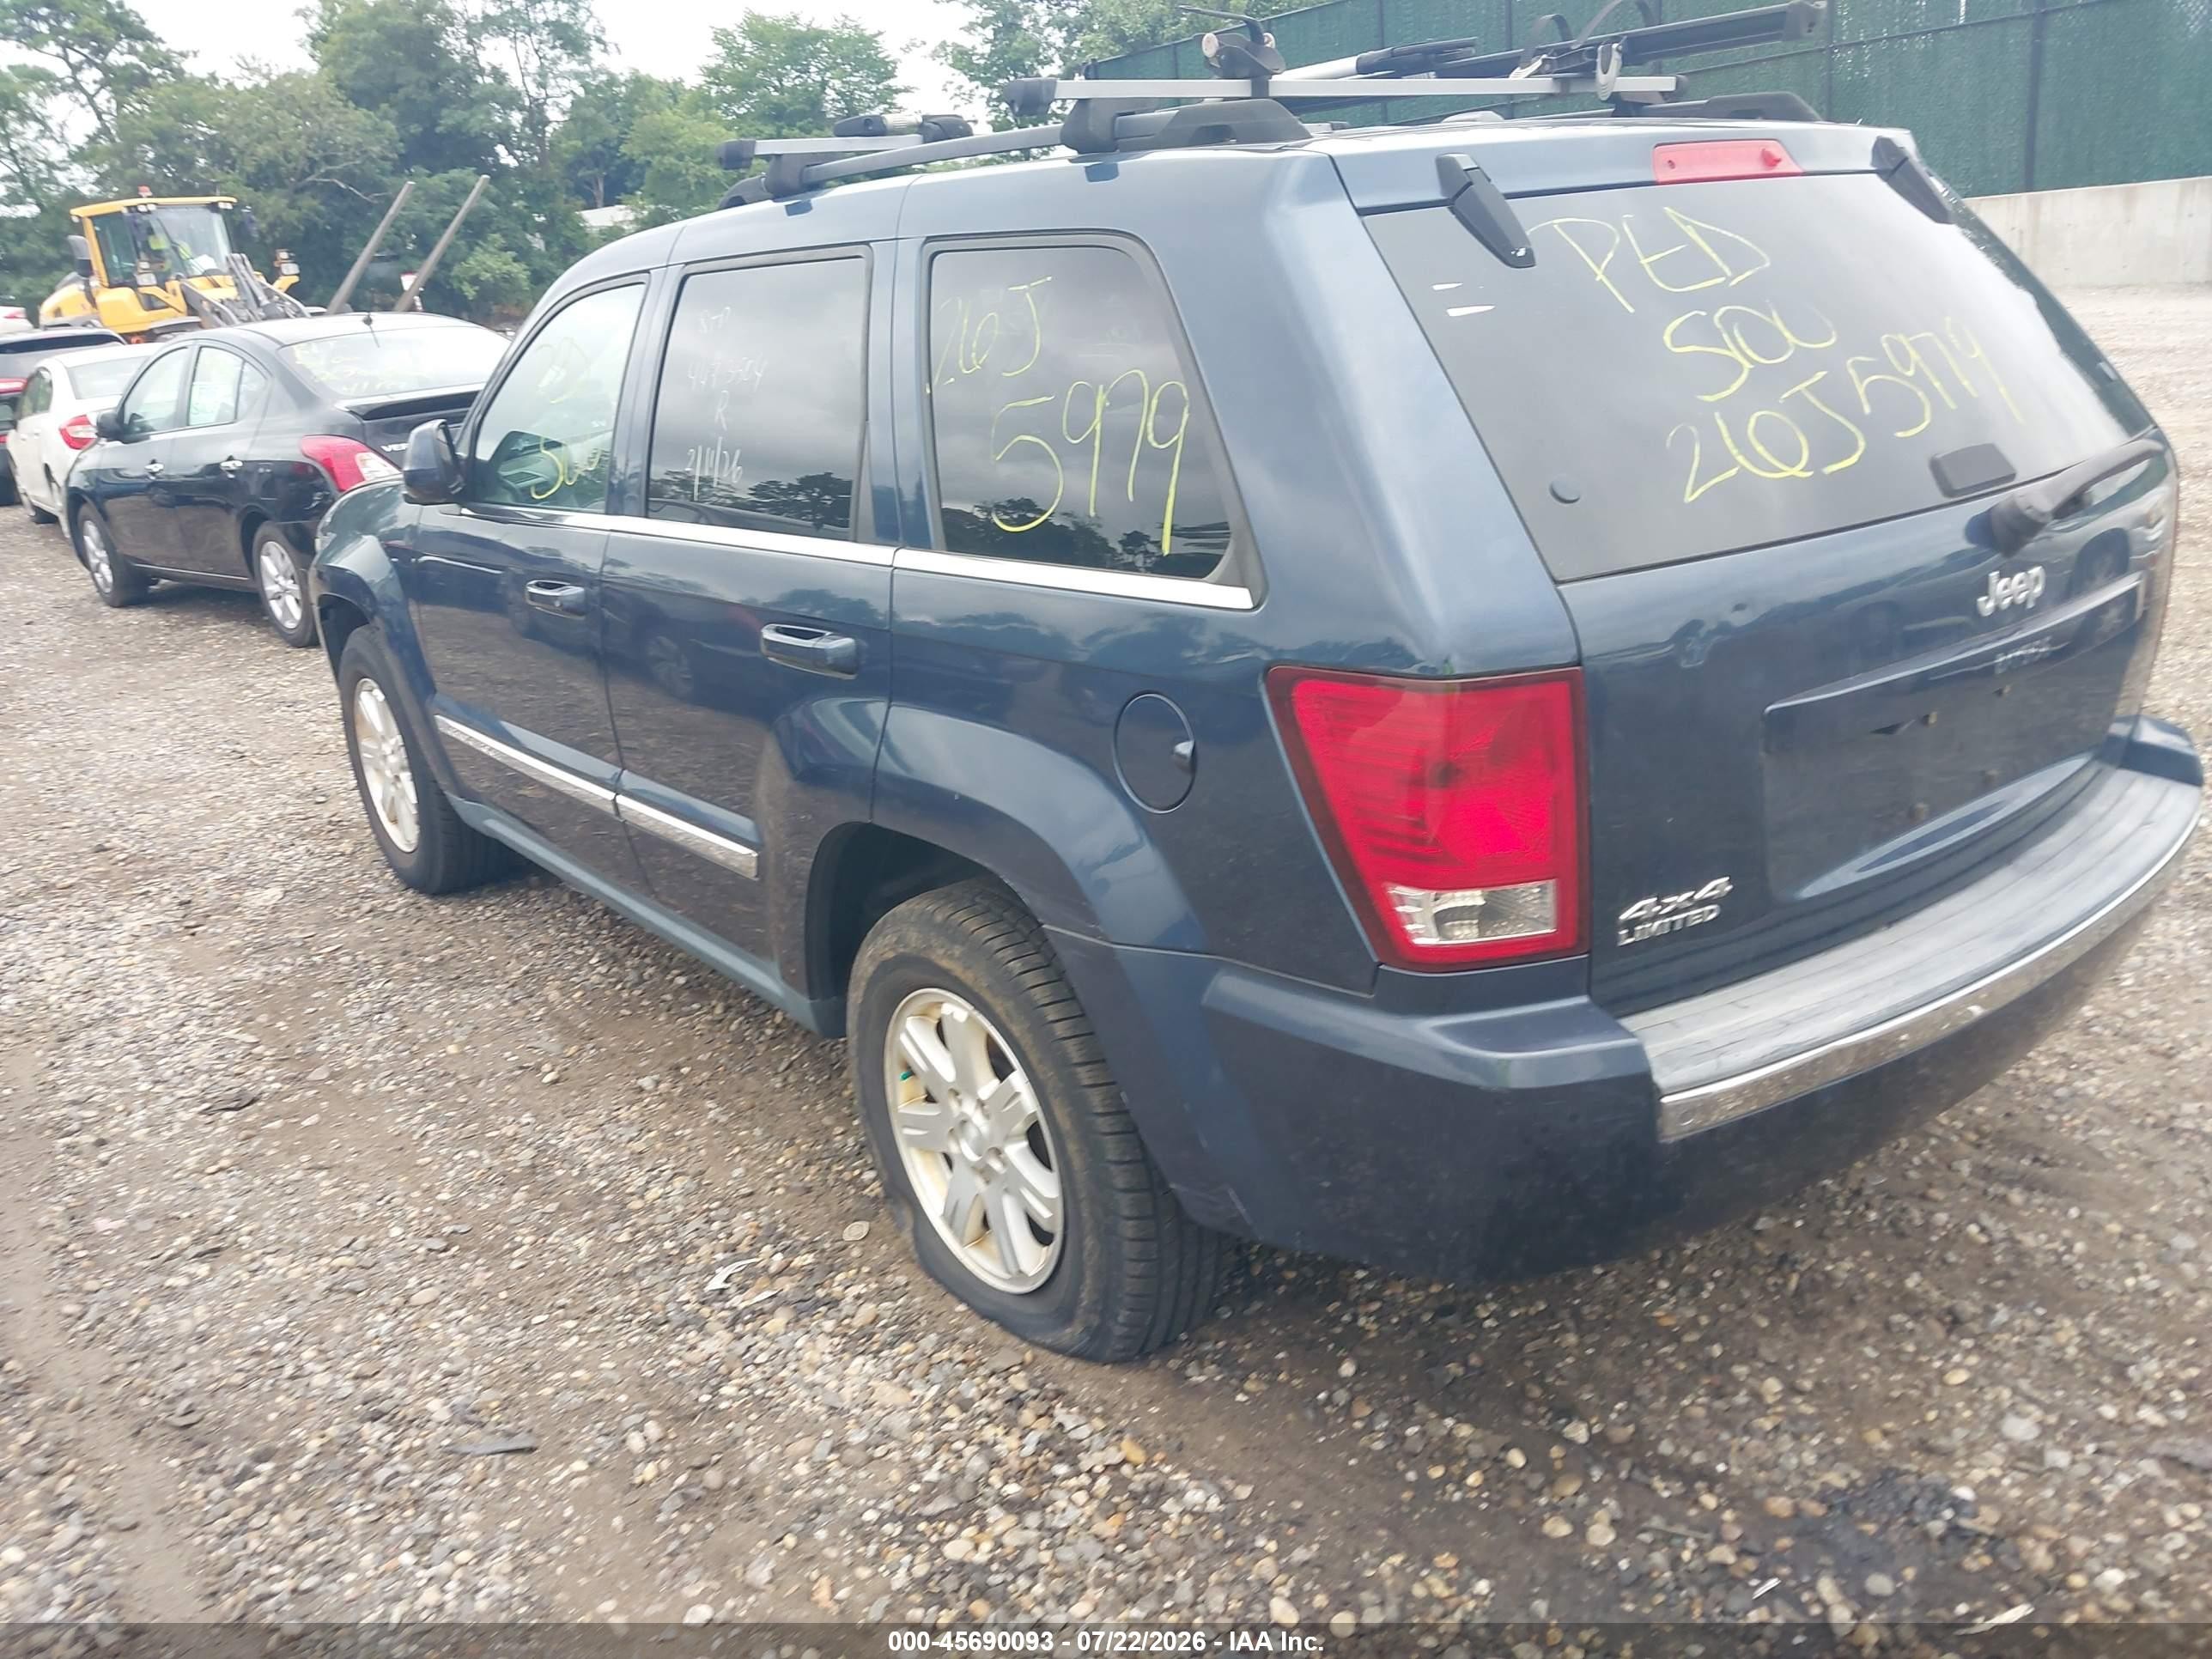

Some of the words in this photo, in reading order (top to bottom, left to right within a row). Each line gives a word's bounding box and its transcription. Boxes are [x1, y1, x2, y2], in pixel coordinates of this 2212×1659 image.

[991, 368, 1189, 556] 5979
[1977, 565, 2046, 617] Jeep
[1618, 876, 1734, 921] 4x4
[1616, 904, 1721, 946] LIMITED
